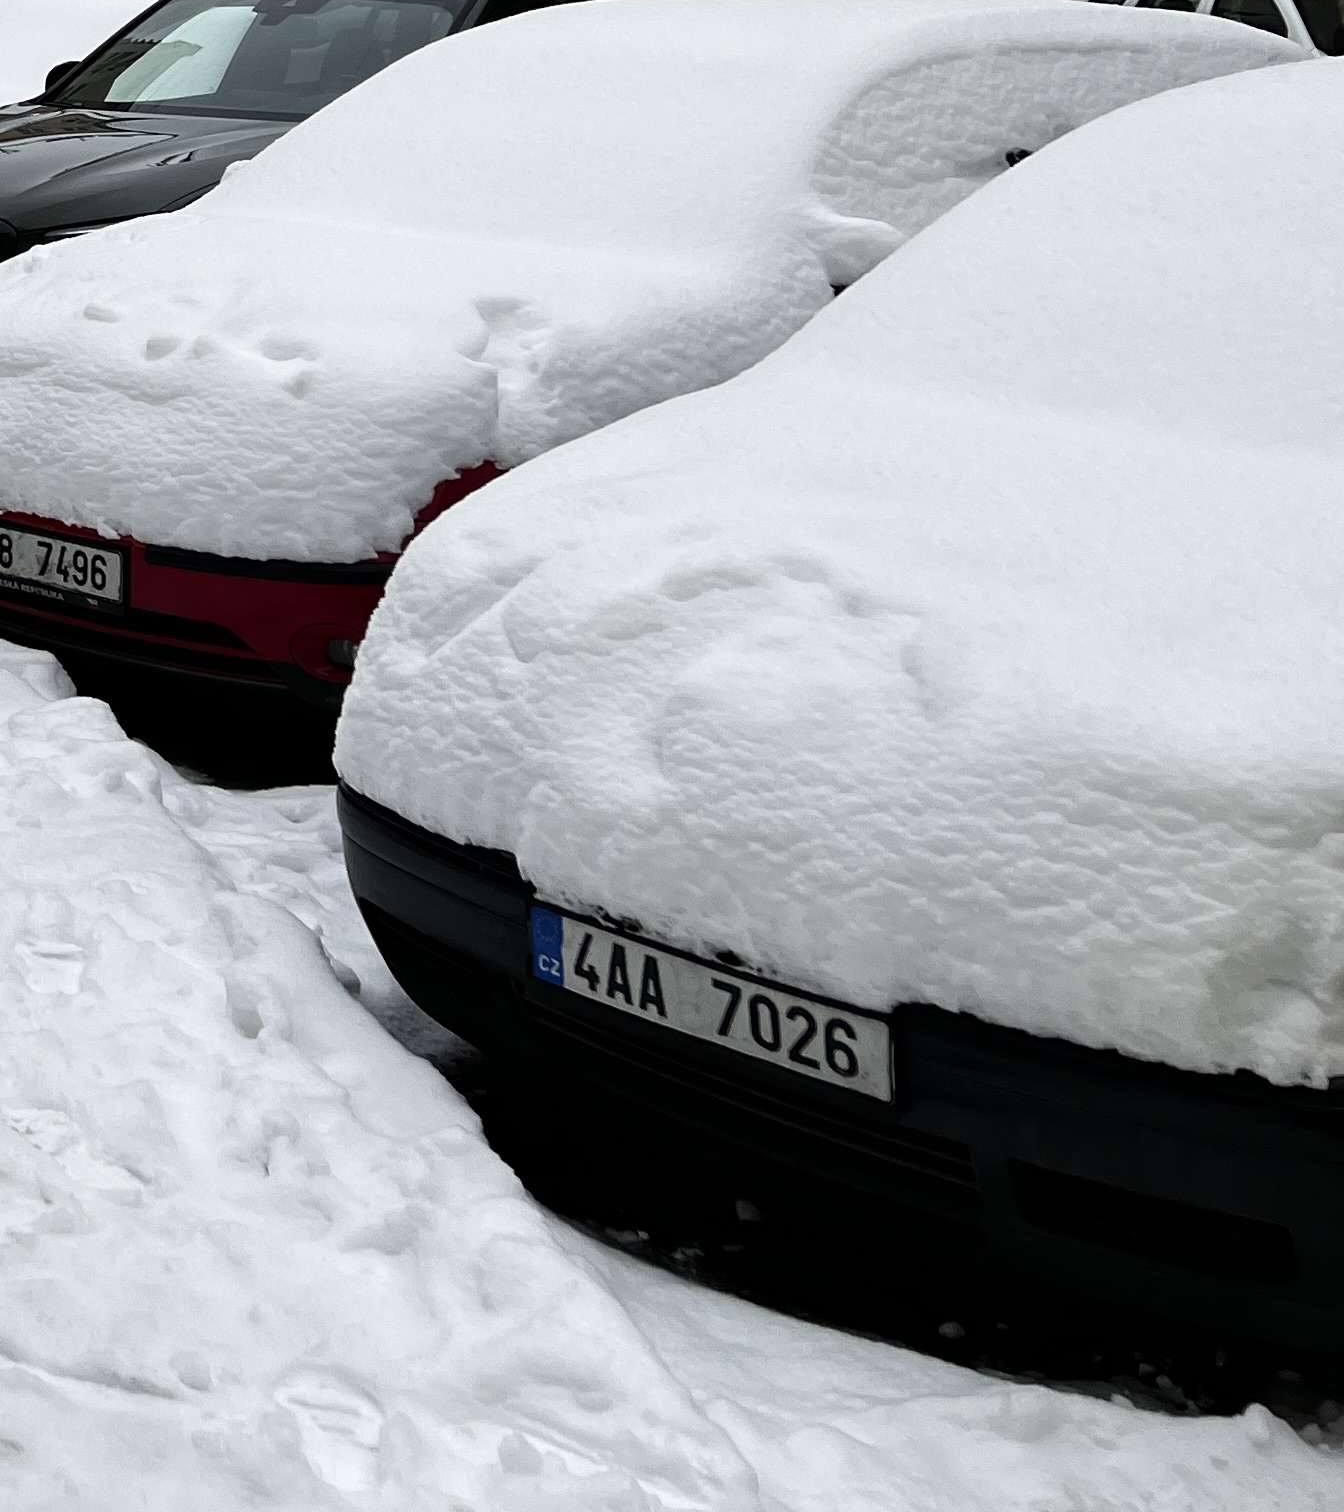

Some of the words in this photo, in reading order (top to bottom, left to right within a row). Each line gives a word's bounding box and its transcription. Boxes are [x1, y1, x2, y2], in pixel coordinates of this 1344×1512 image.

[37, 541, 107, 590] 7496
[538, 954, 561, 977] CZ
[574, 933, 668, 1019] 4AA
[711, 978, 859, 1078] 7026
